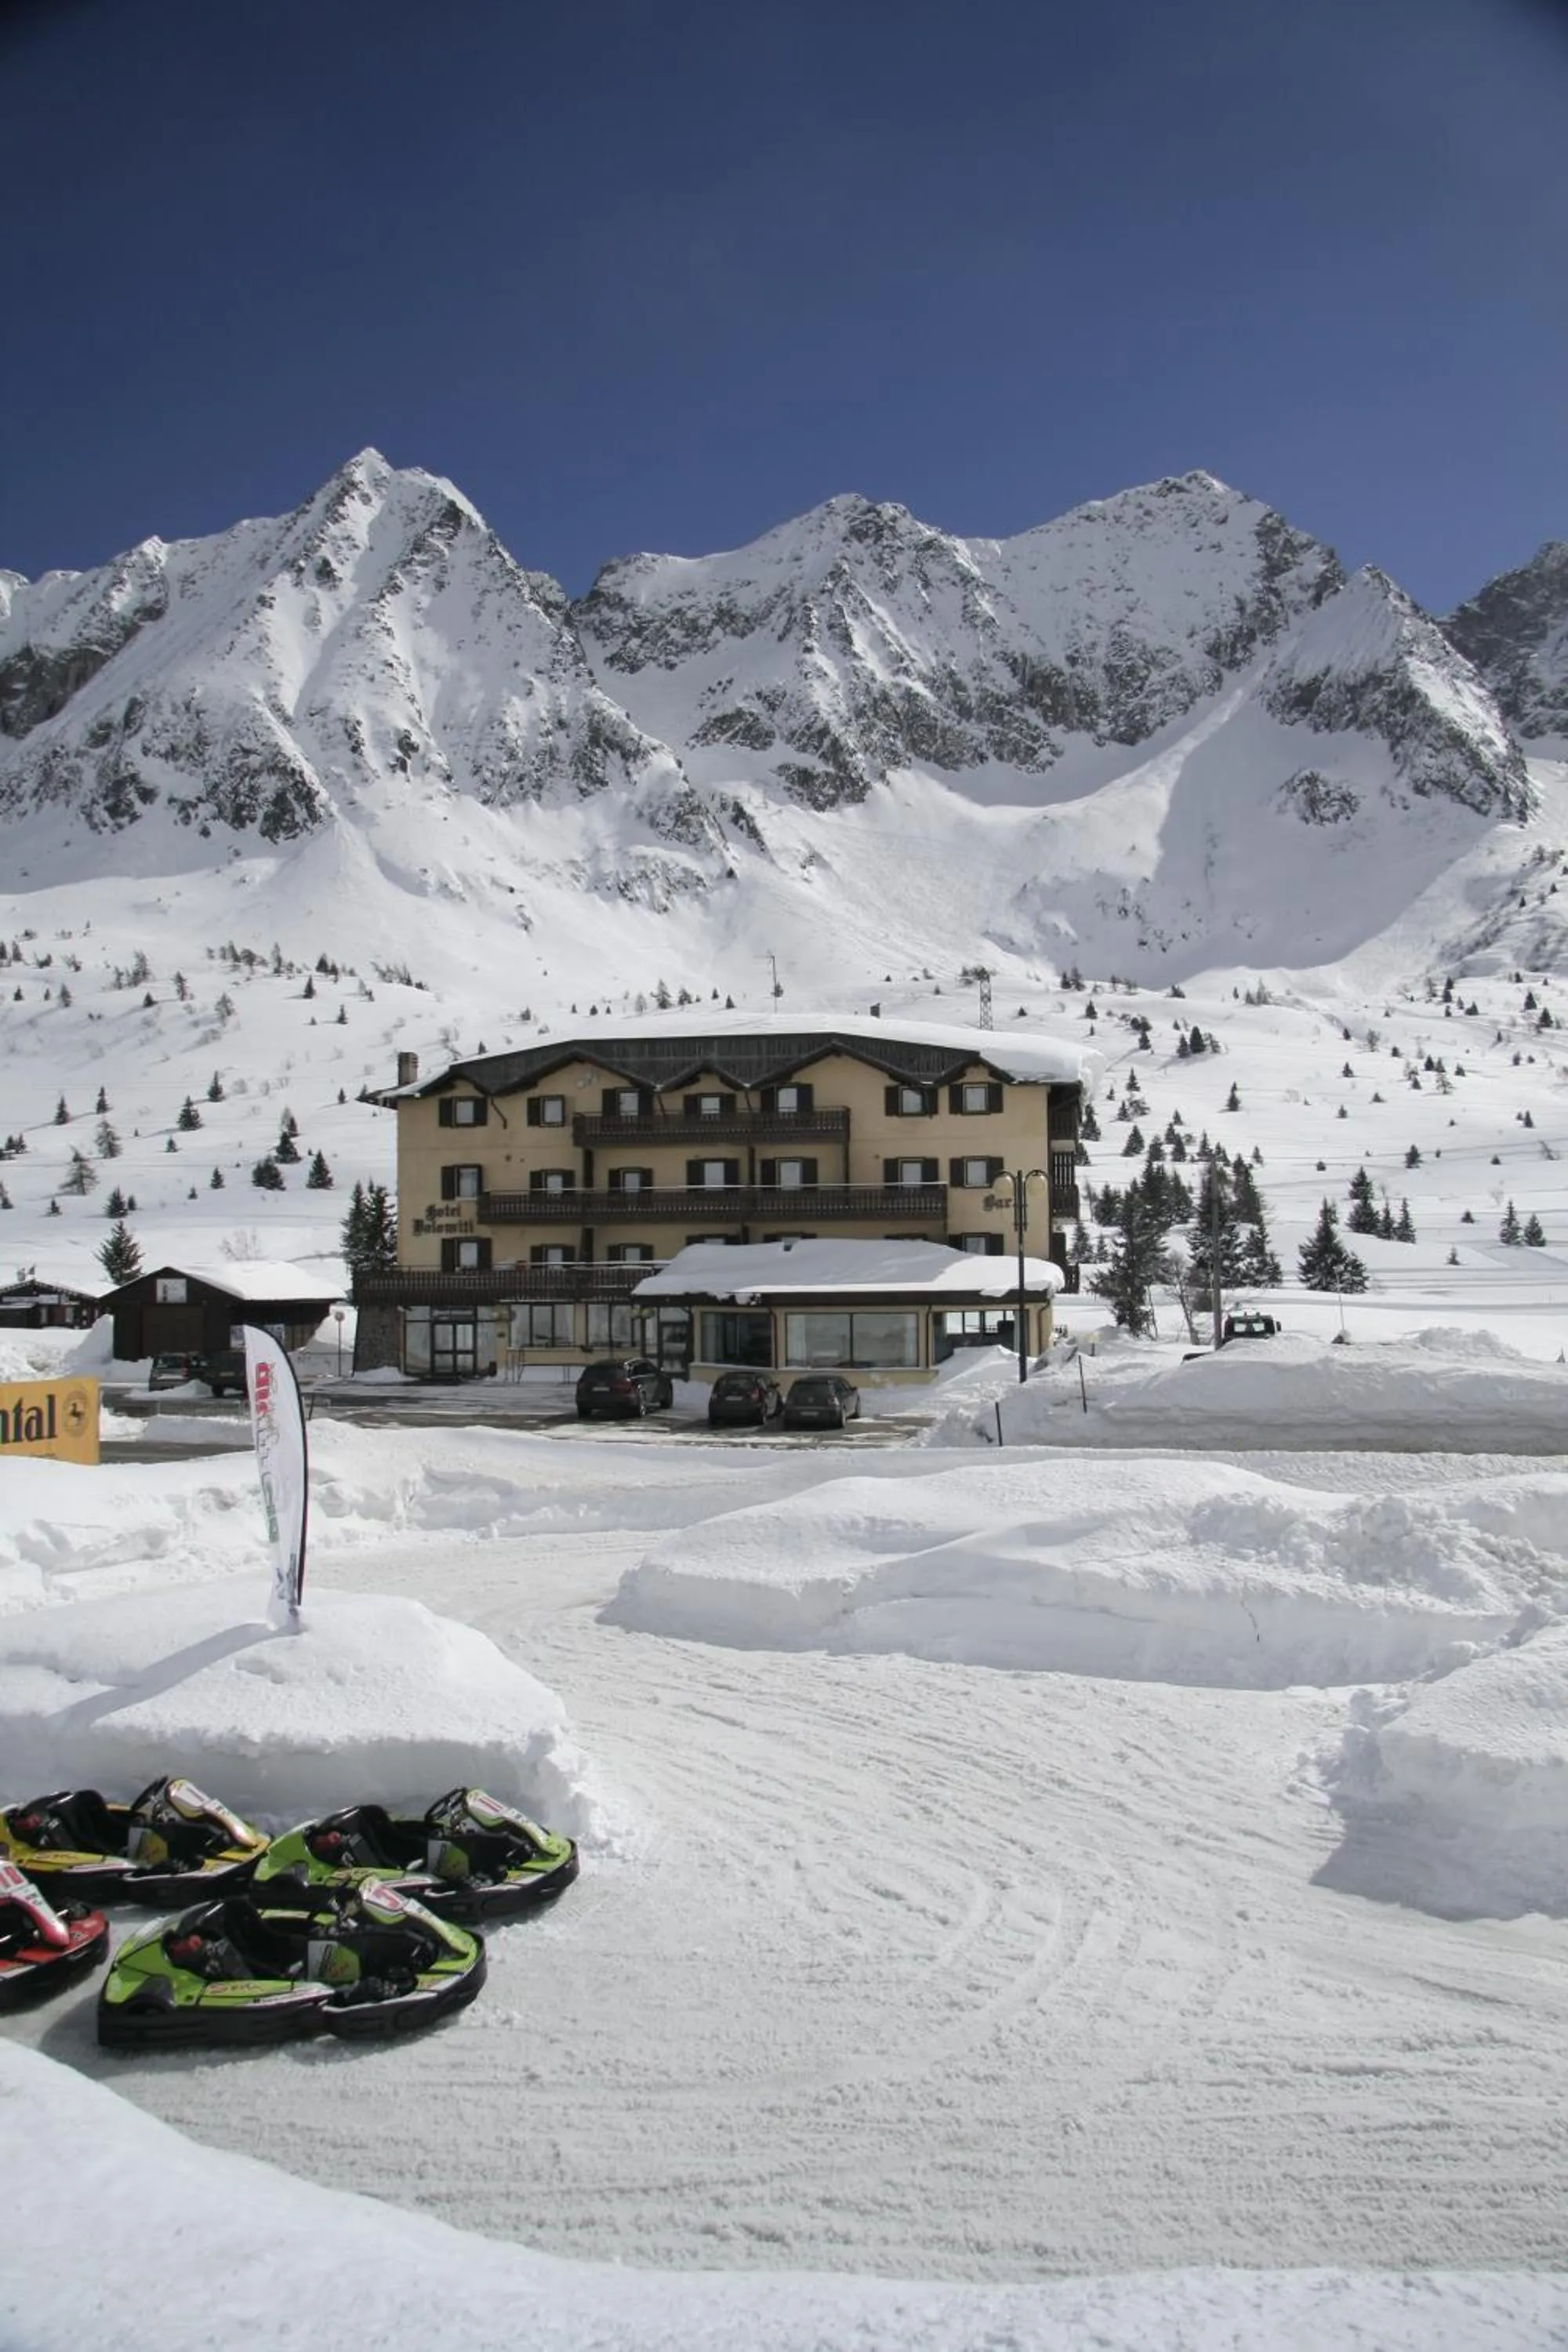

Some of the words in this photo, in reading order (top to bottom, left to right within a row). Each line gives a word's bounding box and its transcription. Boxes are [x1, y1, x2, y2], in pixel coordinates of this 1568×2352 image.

[983, 1193, 1012, 1211] Bar
[425, 1203, 461, 1221] Hotel
[412, 1218, 474, 1236] Dolomiti
